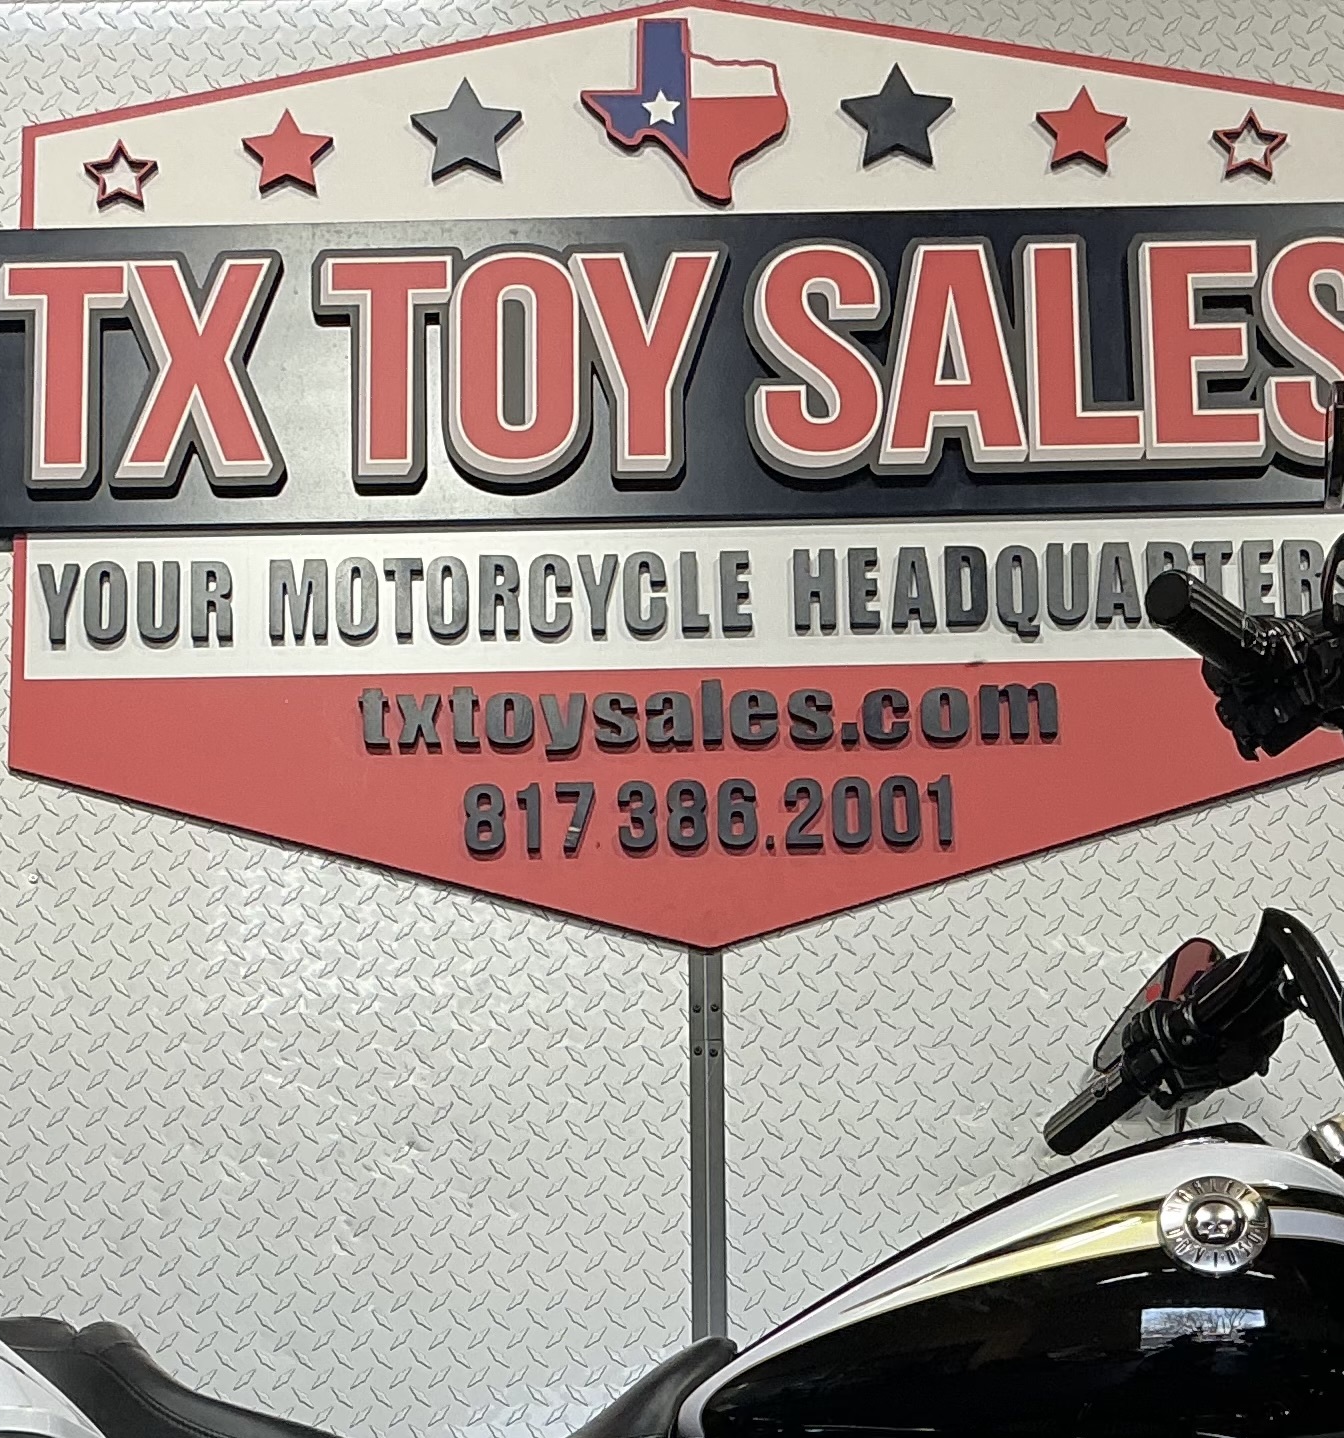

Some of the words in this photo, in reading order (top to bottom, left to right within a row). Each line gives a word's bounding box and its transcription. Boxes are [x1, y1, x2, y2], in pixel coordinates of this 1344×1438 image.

[318, 245, 724, 488] TOY
[37, 560, 233, 650] YOUR
[269, 551, 755, 646] MOTORCYCLE
[358, 679, 1058, 758] txtoysales.com
